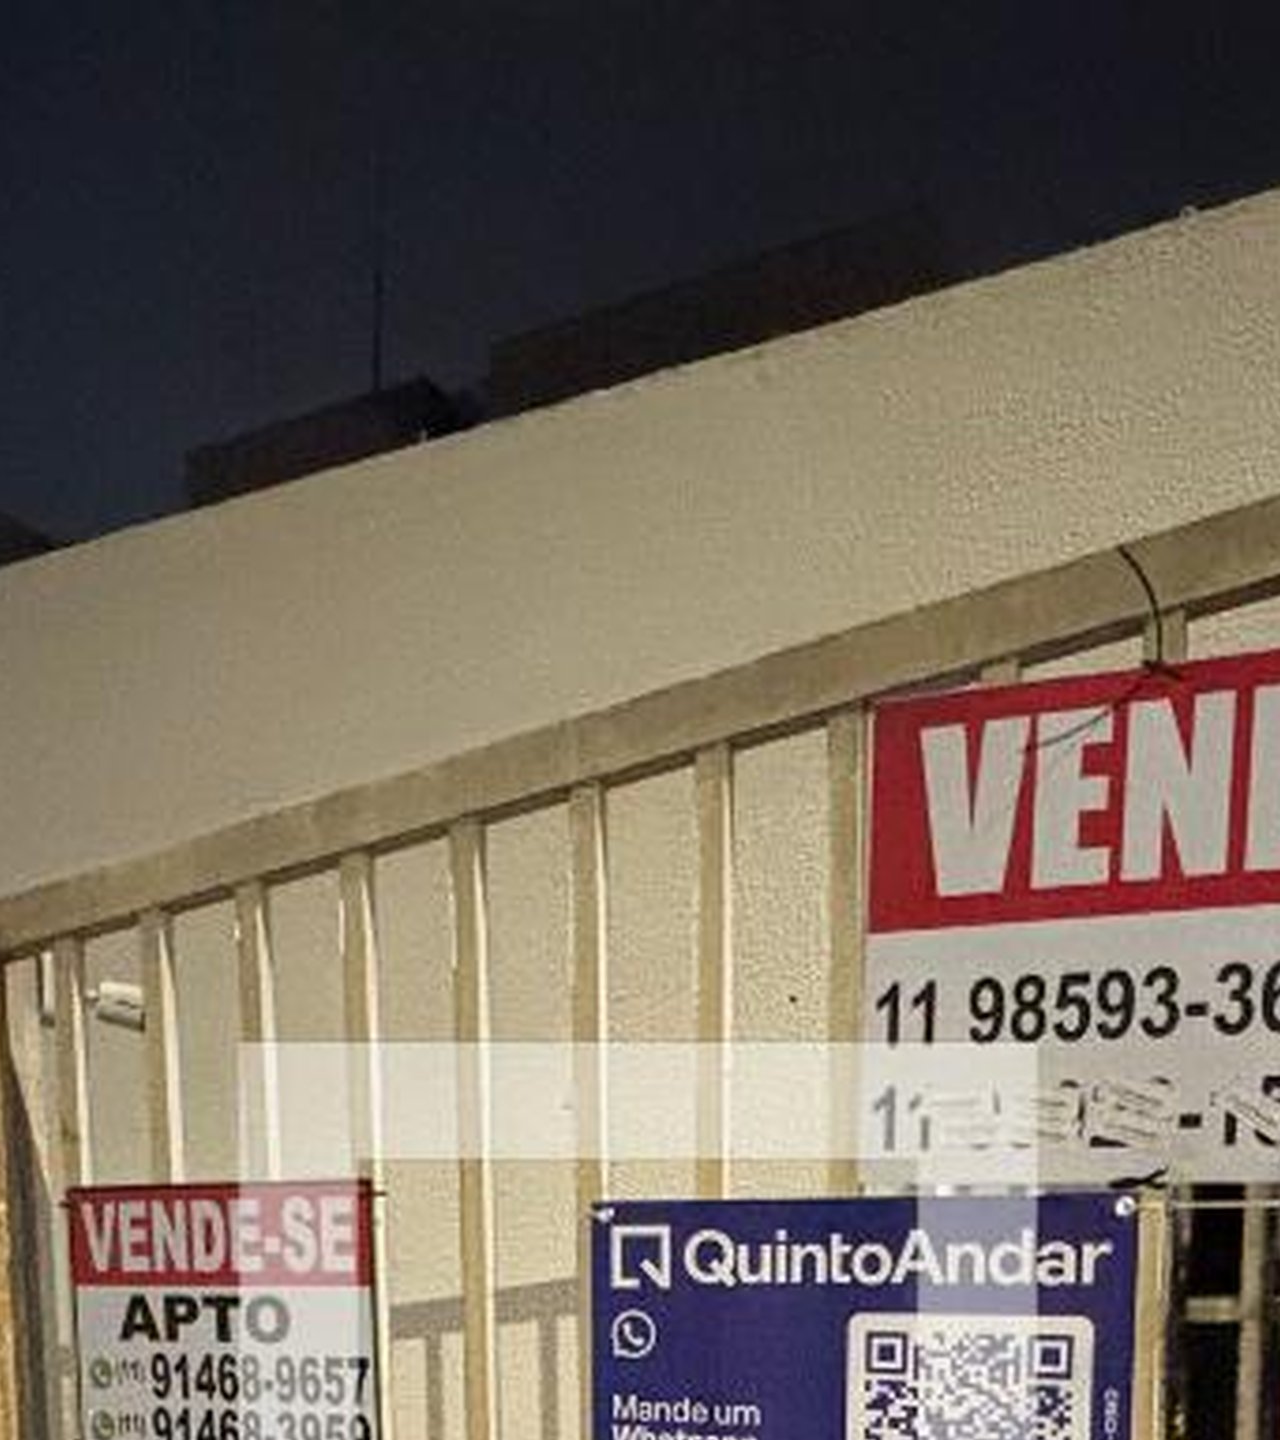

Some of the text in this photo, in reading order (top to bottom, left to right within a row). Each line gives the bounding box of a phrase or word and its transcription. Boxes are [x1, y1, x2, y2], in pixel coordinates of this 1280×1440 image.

[875, 980, 936, 1047] 11
[81, 1197, 357, 1273] VENDE-SE
[684, 1229, 1113, 1288] QuintoAndar
[119, 1294, 291, 1343] APTO
[151, 1352, 370, 1406] 91468-9657
[613, 1394, 761, 1426] Mande um
